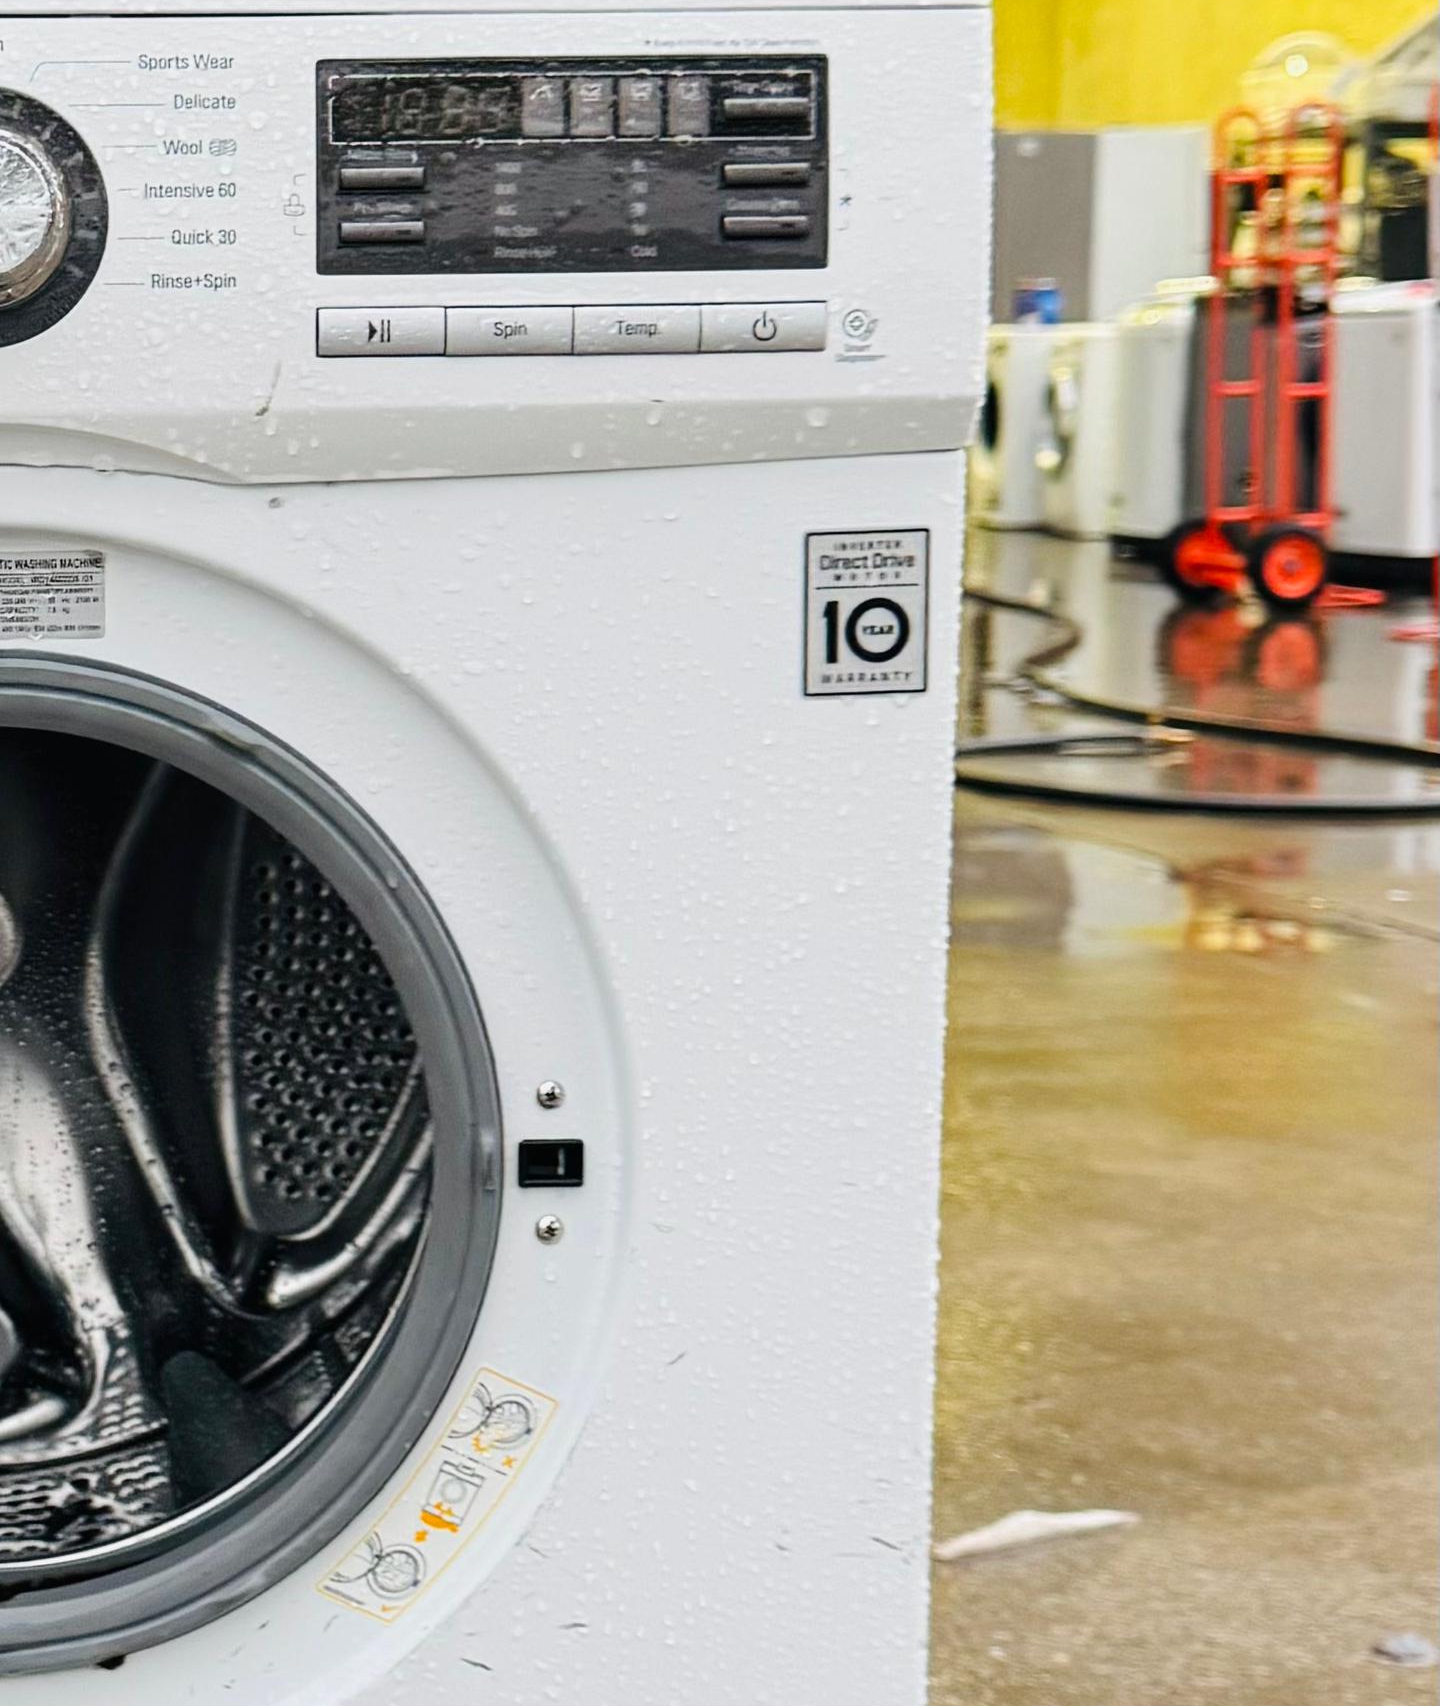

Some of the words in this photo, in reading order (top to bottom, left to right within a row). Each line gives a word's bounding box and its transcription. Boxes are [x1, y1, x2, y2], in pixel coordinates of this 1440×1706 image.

[138, 54, 189, 71] Sports
[193, 54, 235, 70] Wear
[174, 94, 236, 109] Delicate
[163, 139, 203, 155] Wool
[144, 182, 214, 198] Intensive
[218, 182, 236, 198] 60
[171, 229, 213, 245] Quick
[218, 229, 237, 245] 30
[151, 273, 237, 291] Rinse+Spin
[493, 321, 528, 339] Spin
[15, 558, 57, 570] WASHING
[819, 554, 869, 570] Direct
[872, 553, 915, 569] Drive
[822, 597, 910, 663] 10
[821, 671, 913, 684] WARRANTY
